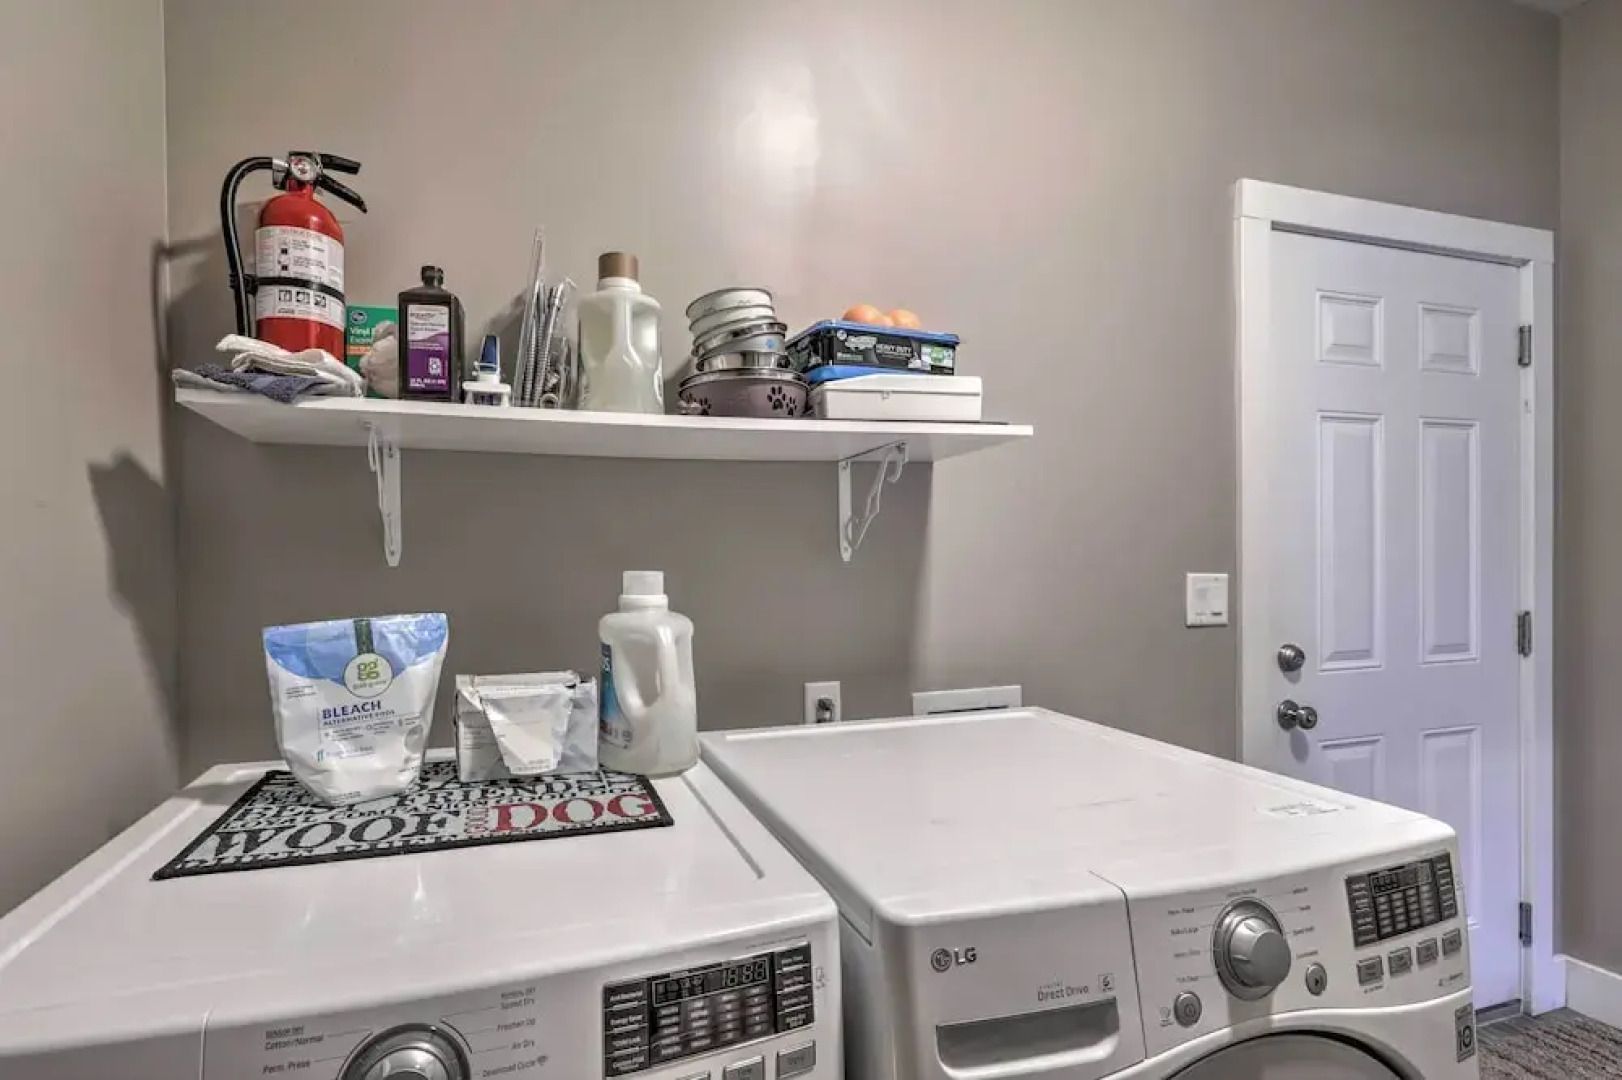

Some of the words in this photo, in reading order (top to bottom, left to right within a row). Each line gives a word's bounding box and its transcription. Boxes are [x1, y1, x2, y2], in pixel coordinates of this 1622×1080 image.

[322, 700, 382, 720] BLEACH
[323, 713, 373, 727] ALTERNATIVE
[491, 793, 657, 832] DOG
[214, 811, 460, 855] WOOF
[954, 946, 977, 966] LG
[1038, 988, 1064, 1001] Direct
[1066, 985, 1089, 997] Drive
